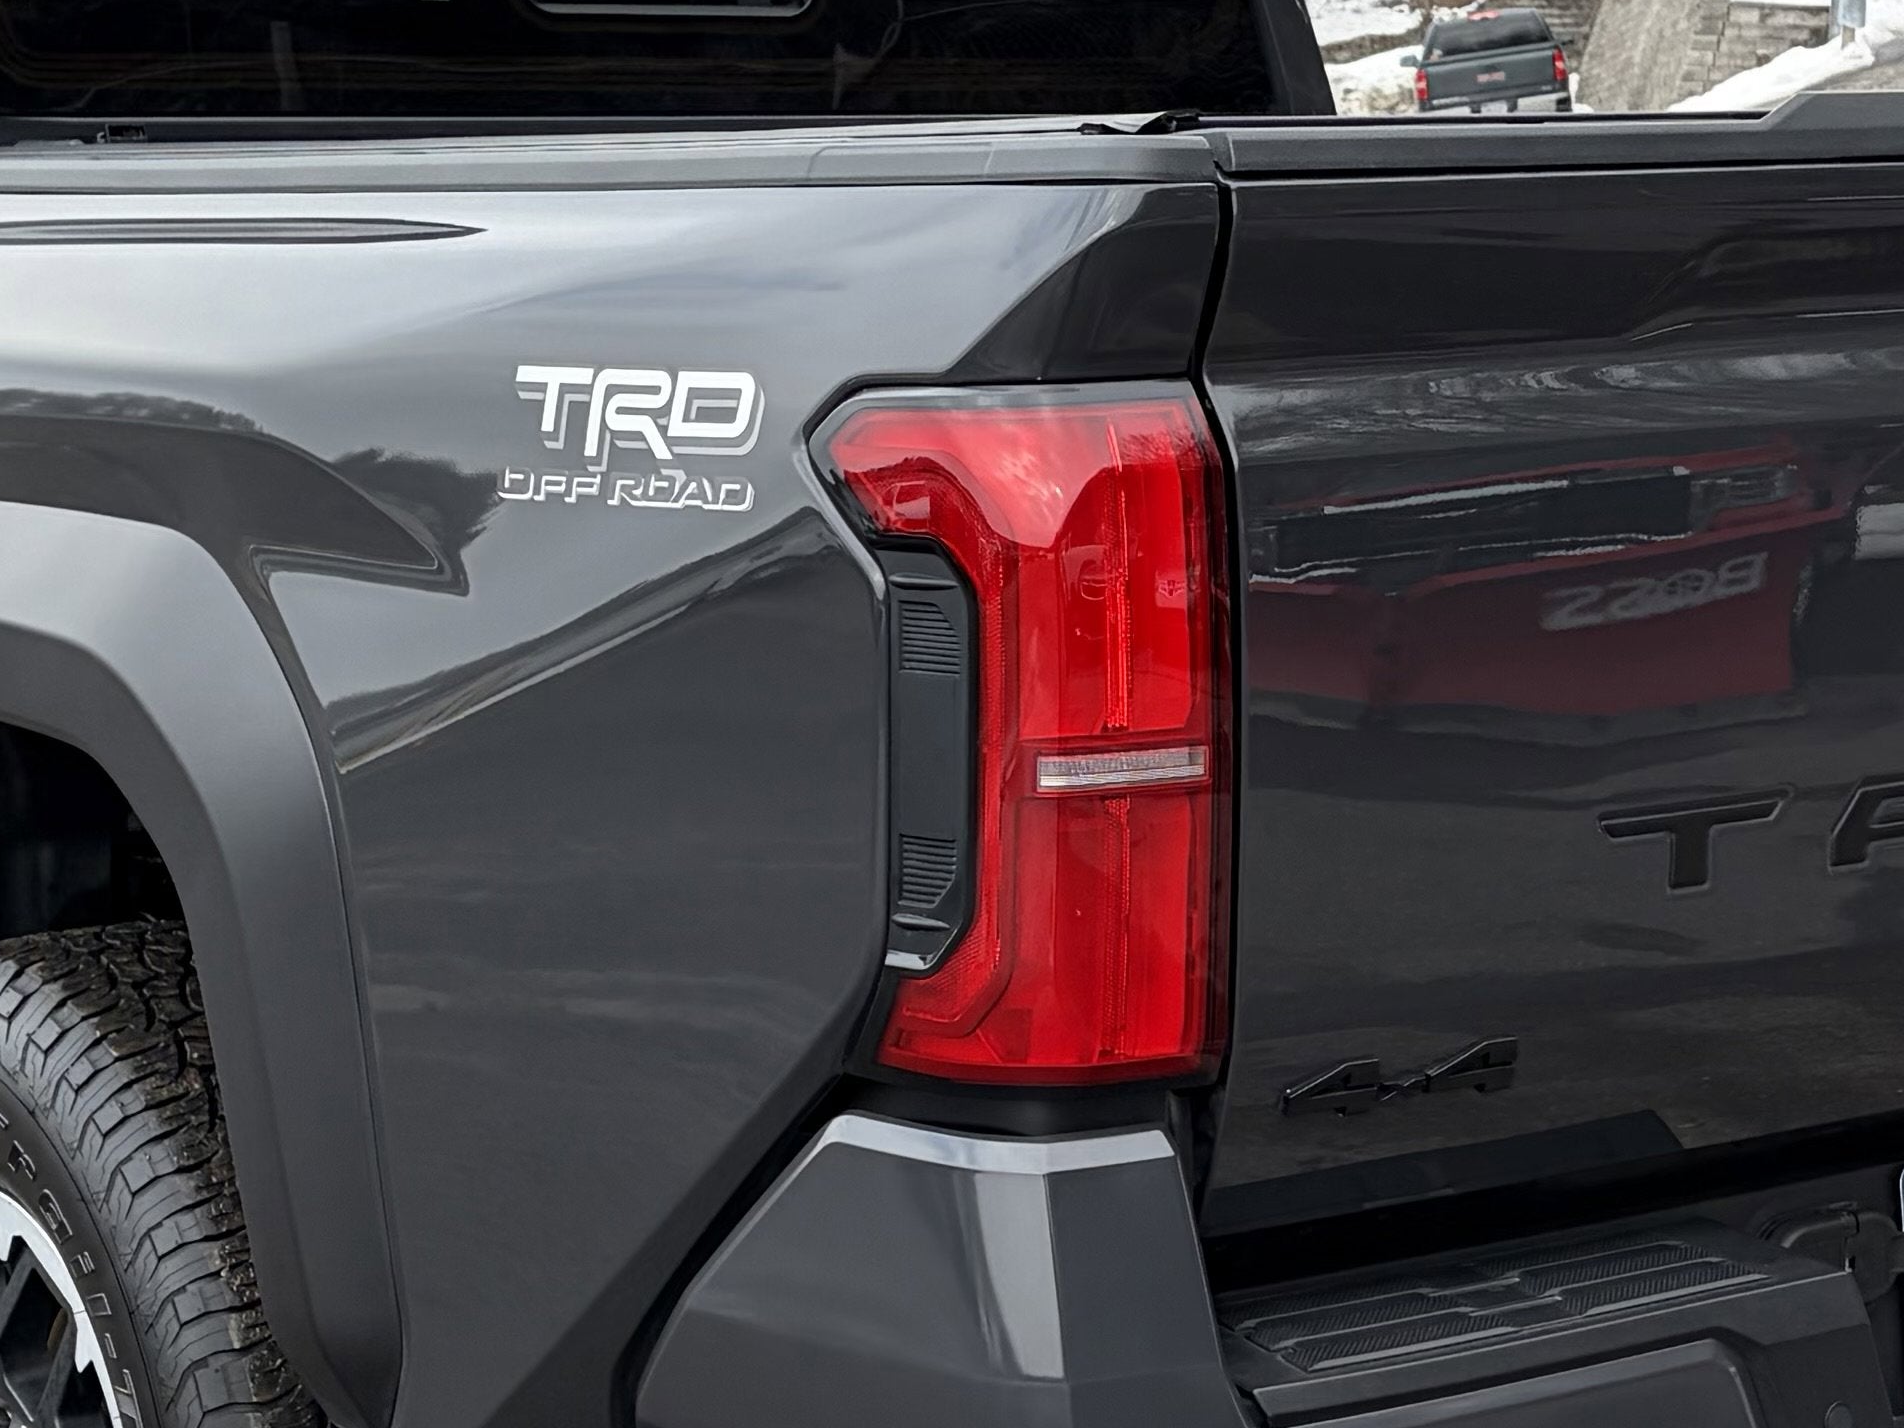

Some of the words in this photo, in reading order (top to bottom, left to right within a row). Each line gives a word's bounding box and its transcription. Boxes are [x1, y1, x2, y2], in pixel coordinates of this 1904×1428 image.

[514, 364, 766, 472] TRD
[497, 466, 601, 504] OFF
[606, 471, 756, 512] ROAD
